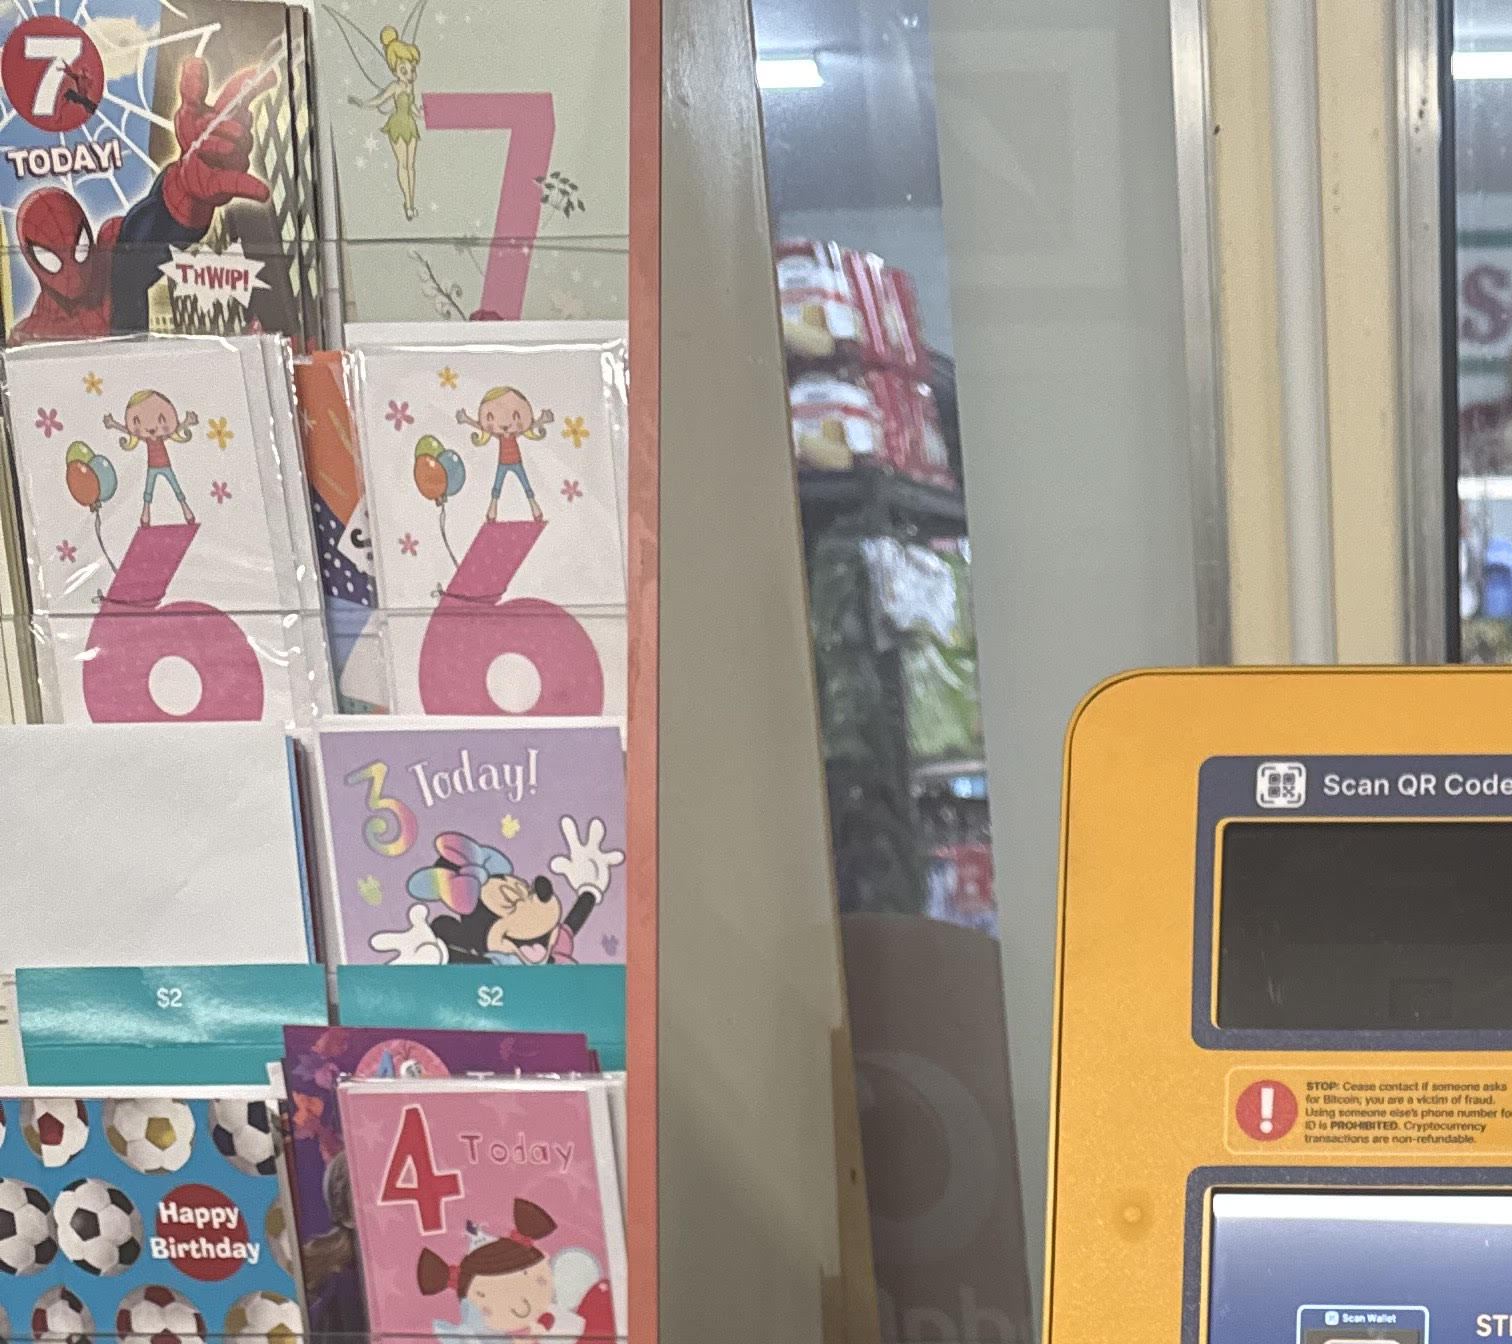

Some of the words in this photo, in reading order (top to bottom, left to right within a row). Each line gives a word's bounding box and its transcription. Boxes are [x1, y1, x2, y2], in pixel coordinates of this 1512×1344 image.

[25, 35, 83, 116] 7
[7, 138, 122, 178] TODAY!
[422, 92, 556, 321] 7
[1323, 774, 1389, 796] Scan
[1398, 774, 1436, 798] QR
[344, 761, 418, 857] 3
[408, 748, 539, 807] Today!
[156, 987, 183, 1008] $2
[477, 986, 504, 1006] $2
[1343, 1082, 1376, 1092] Cease
[1379, 1082, 1419, 1092] contact
[1432, 1083, 1480, 1092] someone
[1483, 1082, 1507, 1092] asks
[1306, 1094, 1320, 1105] for
[1365, 1097, 1385, 1106] you
[1387, 1097, 1404, 1105] are
[1417, 1095, 1448, 1105] victim
[1451, 1094, 1463, 1105] of
[1465, 1094, 1495, 1105] fraud.
[1305, 1107, 1335, 1119] Using
[1339, 1109, 1387, 1118] someone
[1390, 1107, 1418, 1118] else's
[1421, 1107, 1455, 1119] phone
[1457, 1107, 1498, 1118] number
[1305, 1121, 1318, 1131] ID
[1403, 1121, 1487, 1133] Cryptocurrency
[1305, 1134, 1370, 1144] transactions
[1372, 1136, 1389, 1144] are
[1392, 1134, 1476, 1145] non-refundable.
[377, 1103, 464, 1236] 4
[459, 1131, 575, 1174] Today
[158, 1201, 239, 1229] Happy
[149, 1236, 260, 1264] Birthday
[1342, 1313, 1366, 1323] Scan
[1367, 1314, 1397, 1323] Wallet
